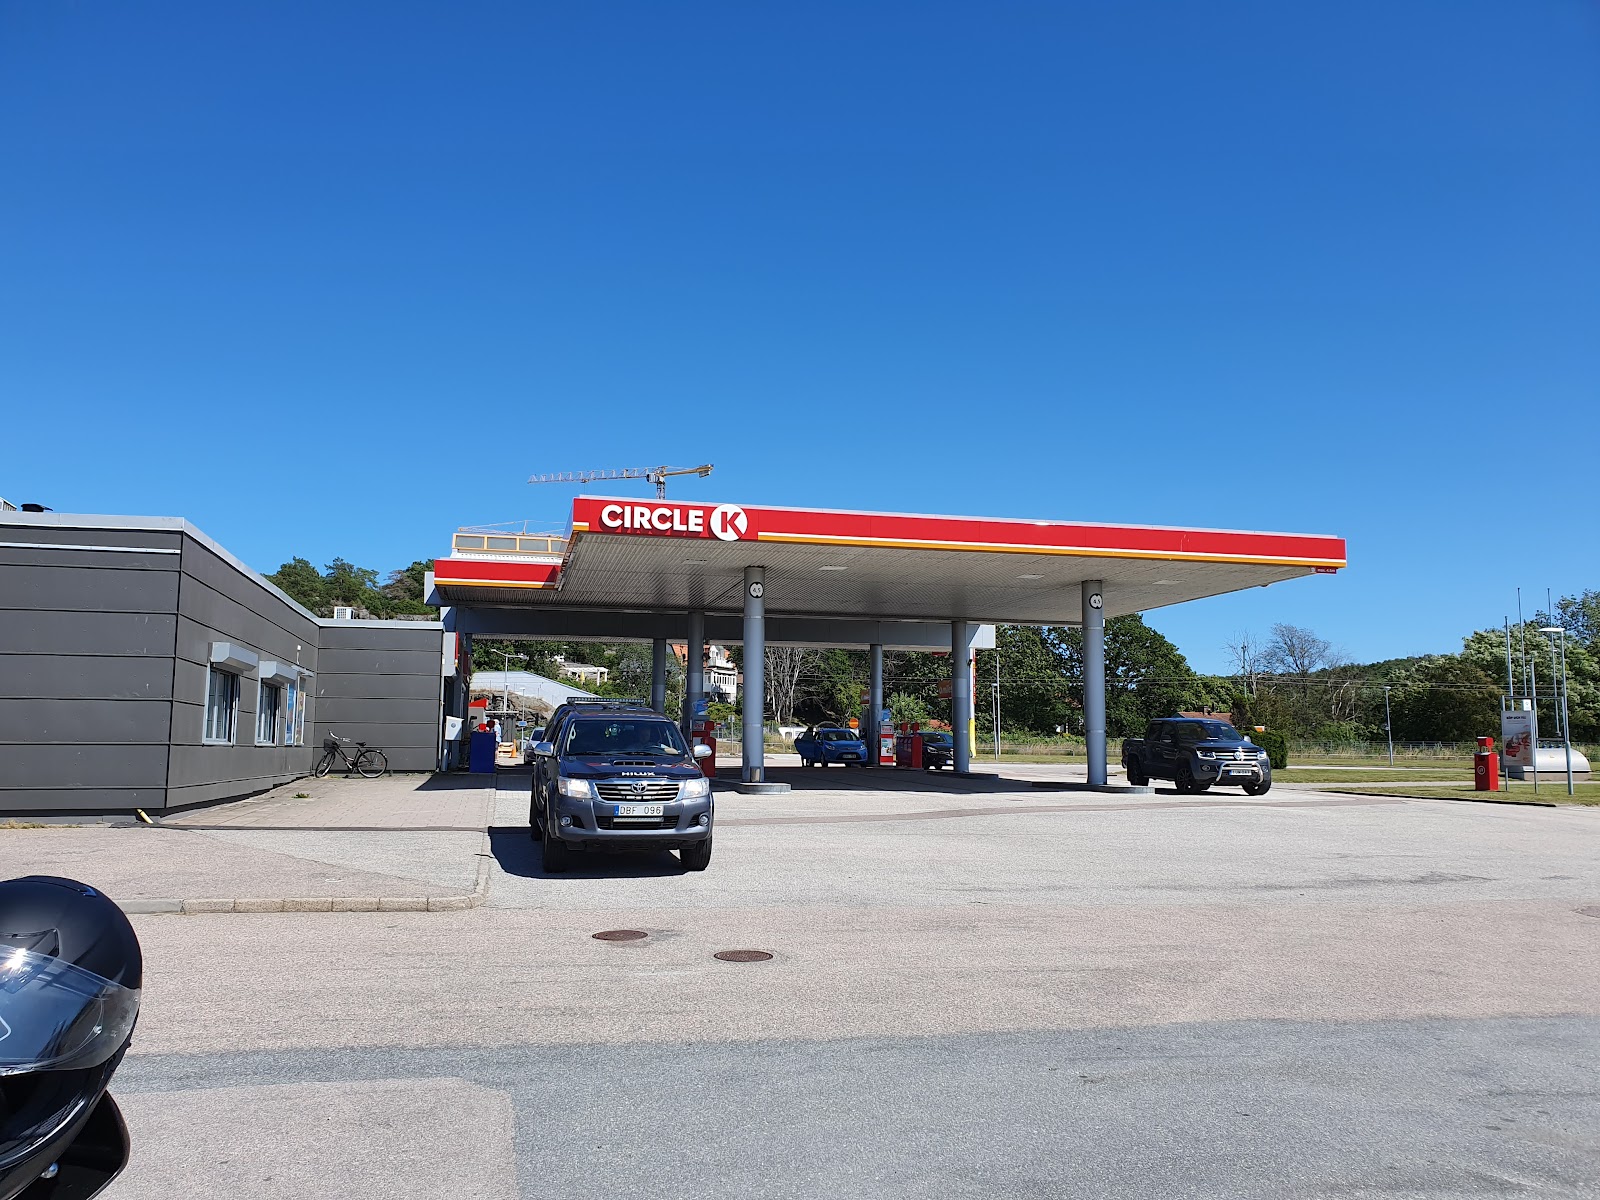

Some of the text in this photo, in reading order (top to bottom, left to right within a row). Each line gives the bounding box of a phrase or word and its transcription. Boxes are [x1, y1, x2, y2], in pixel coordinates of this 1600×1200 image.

[601, 504, 746, 540] CIRCLE K
[620, 806, 661, 815] DBF 096
